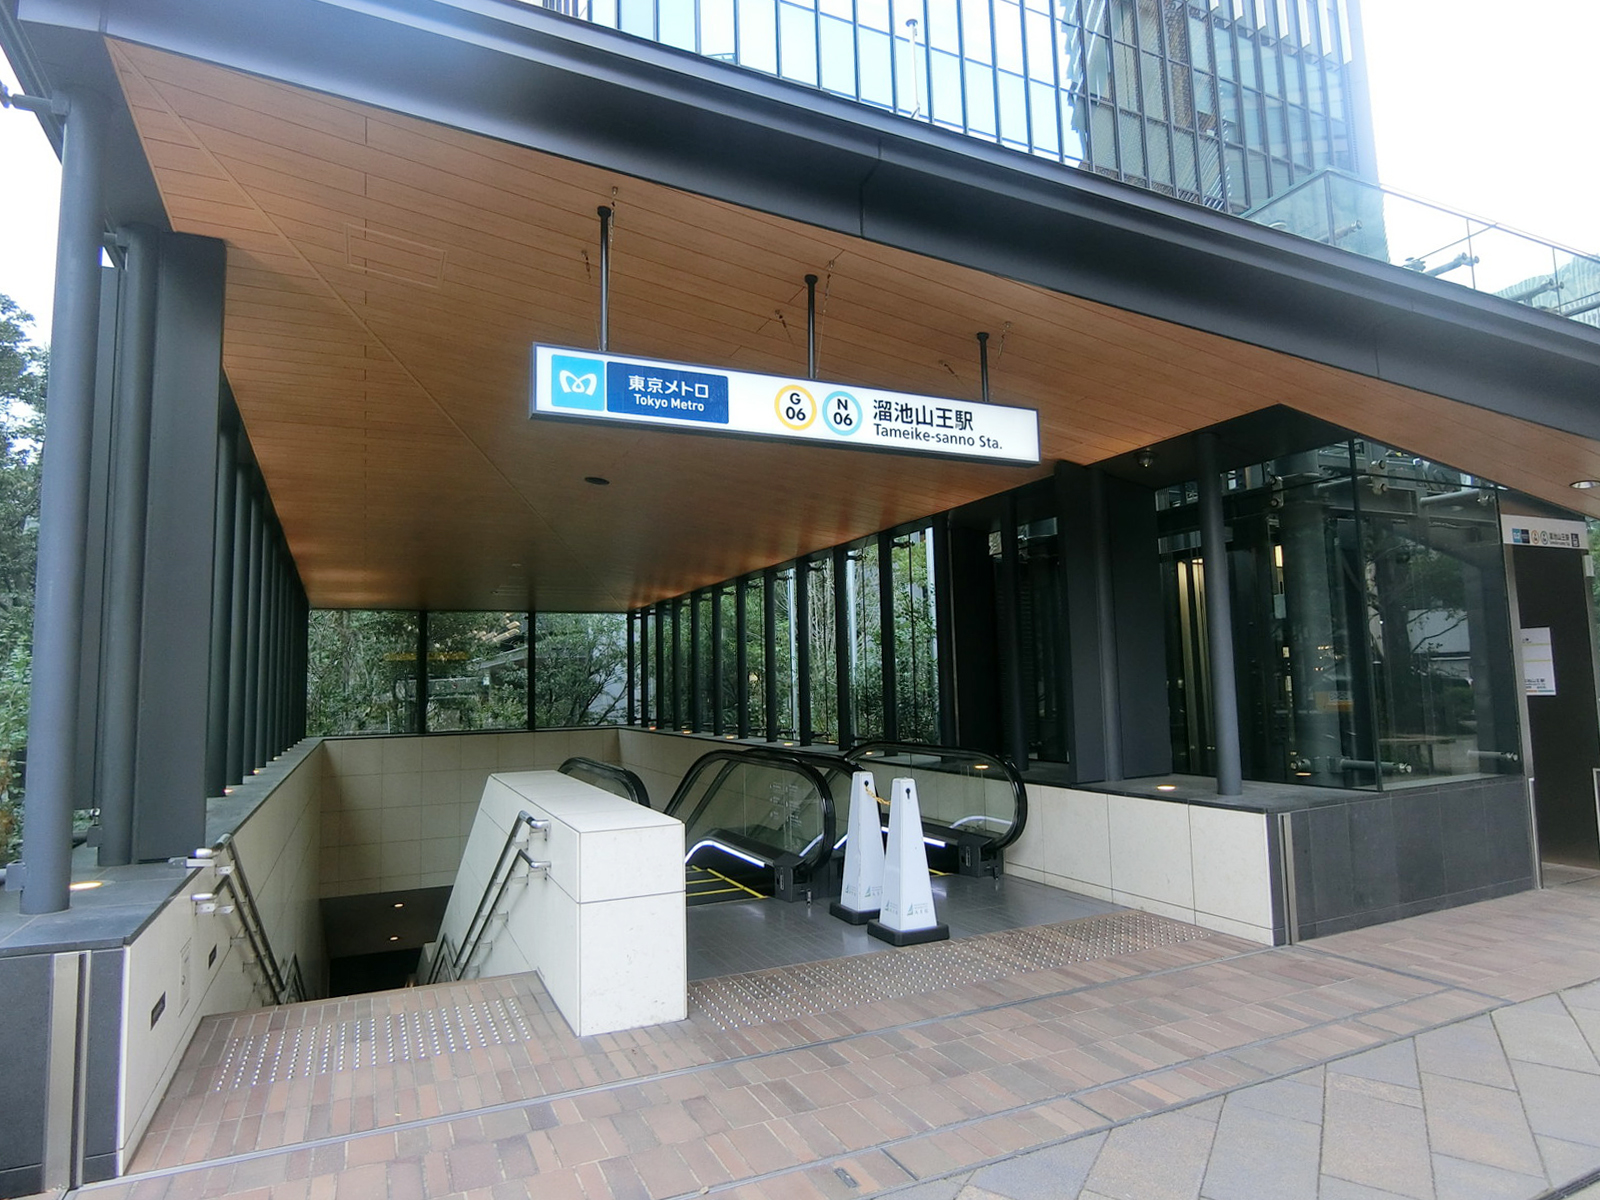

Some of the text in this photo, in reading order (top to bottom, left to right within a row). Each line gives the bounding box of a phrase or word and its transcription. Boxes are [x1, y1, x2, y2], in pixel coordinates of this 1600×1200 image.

[628, 375, 709, 398] 東京メトロ
[633, 393, 705, 412] Tokyo Metro
[789, 392, 801, 405] G
[837, 398, 848, 411] N
[785, 406, 806, 421] 06
[833, 412, 853, 426] 06
[873, 399, 974, 431] 溜池山王駅
[873, 423, 1003, 449] Tameike-sanno Sta.
